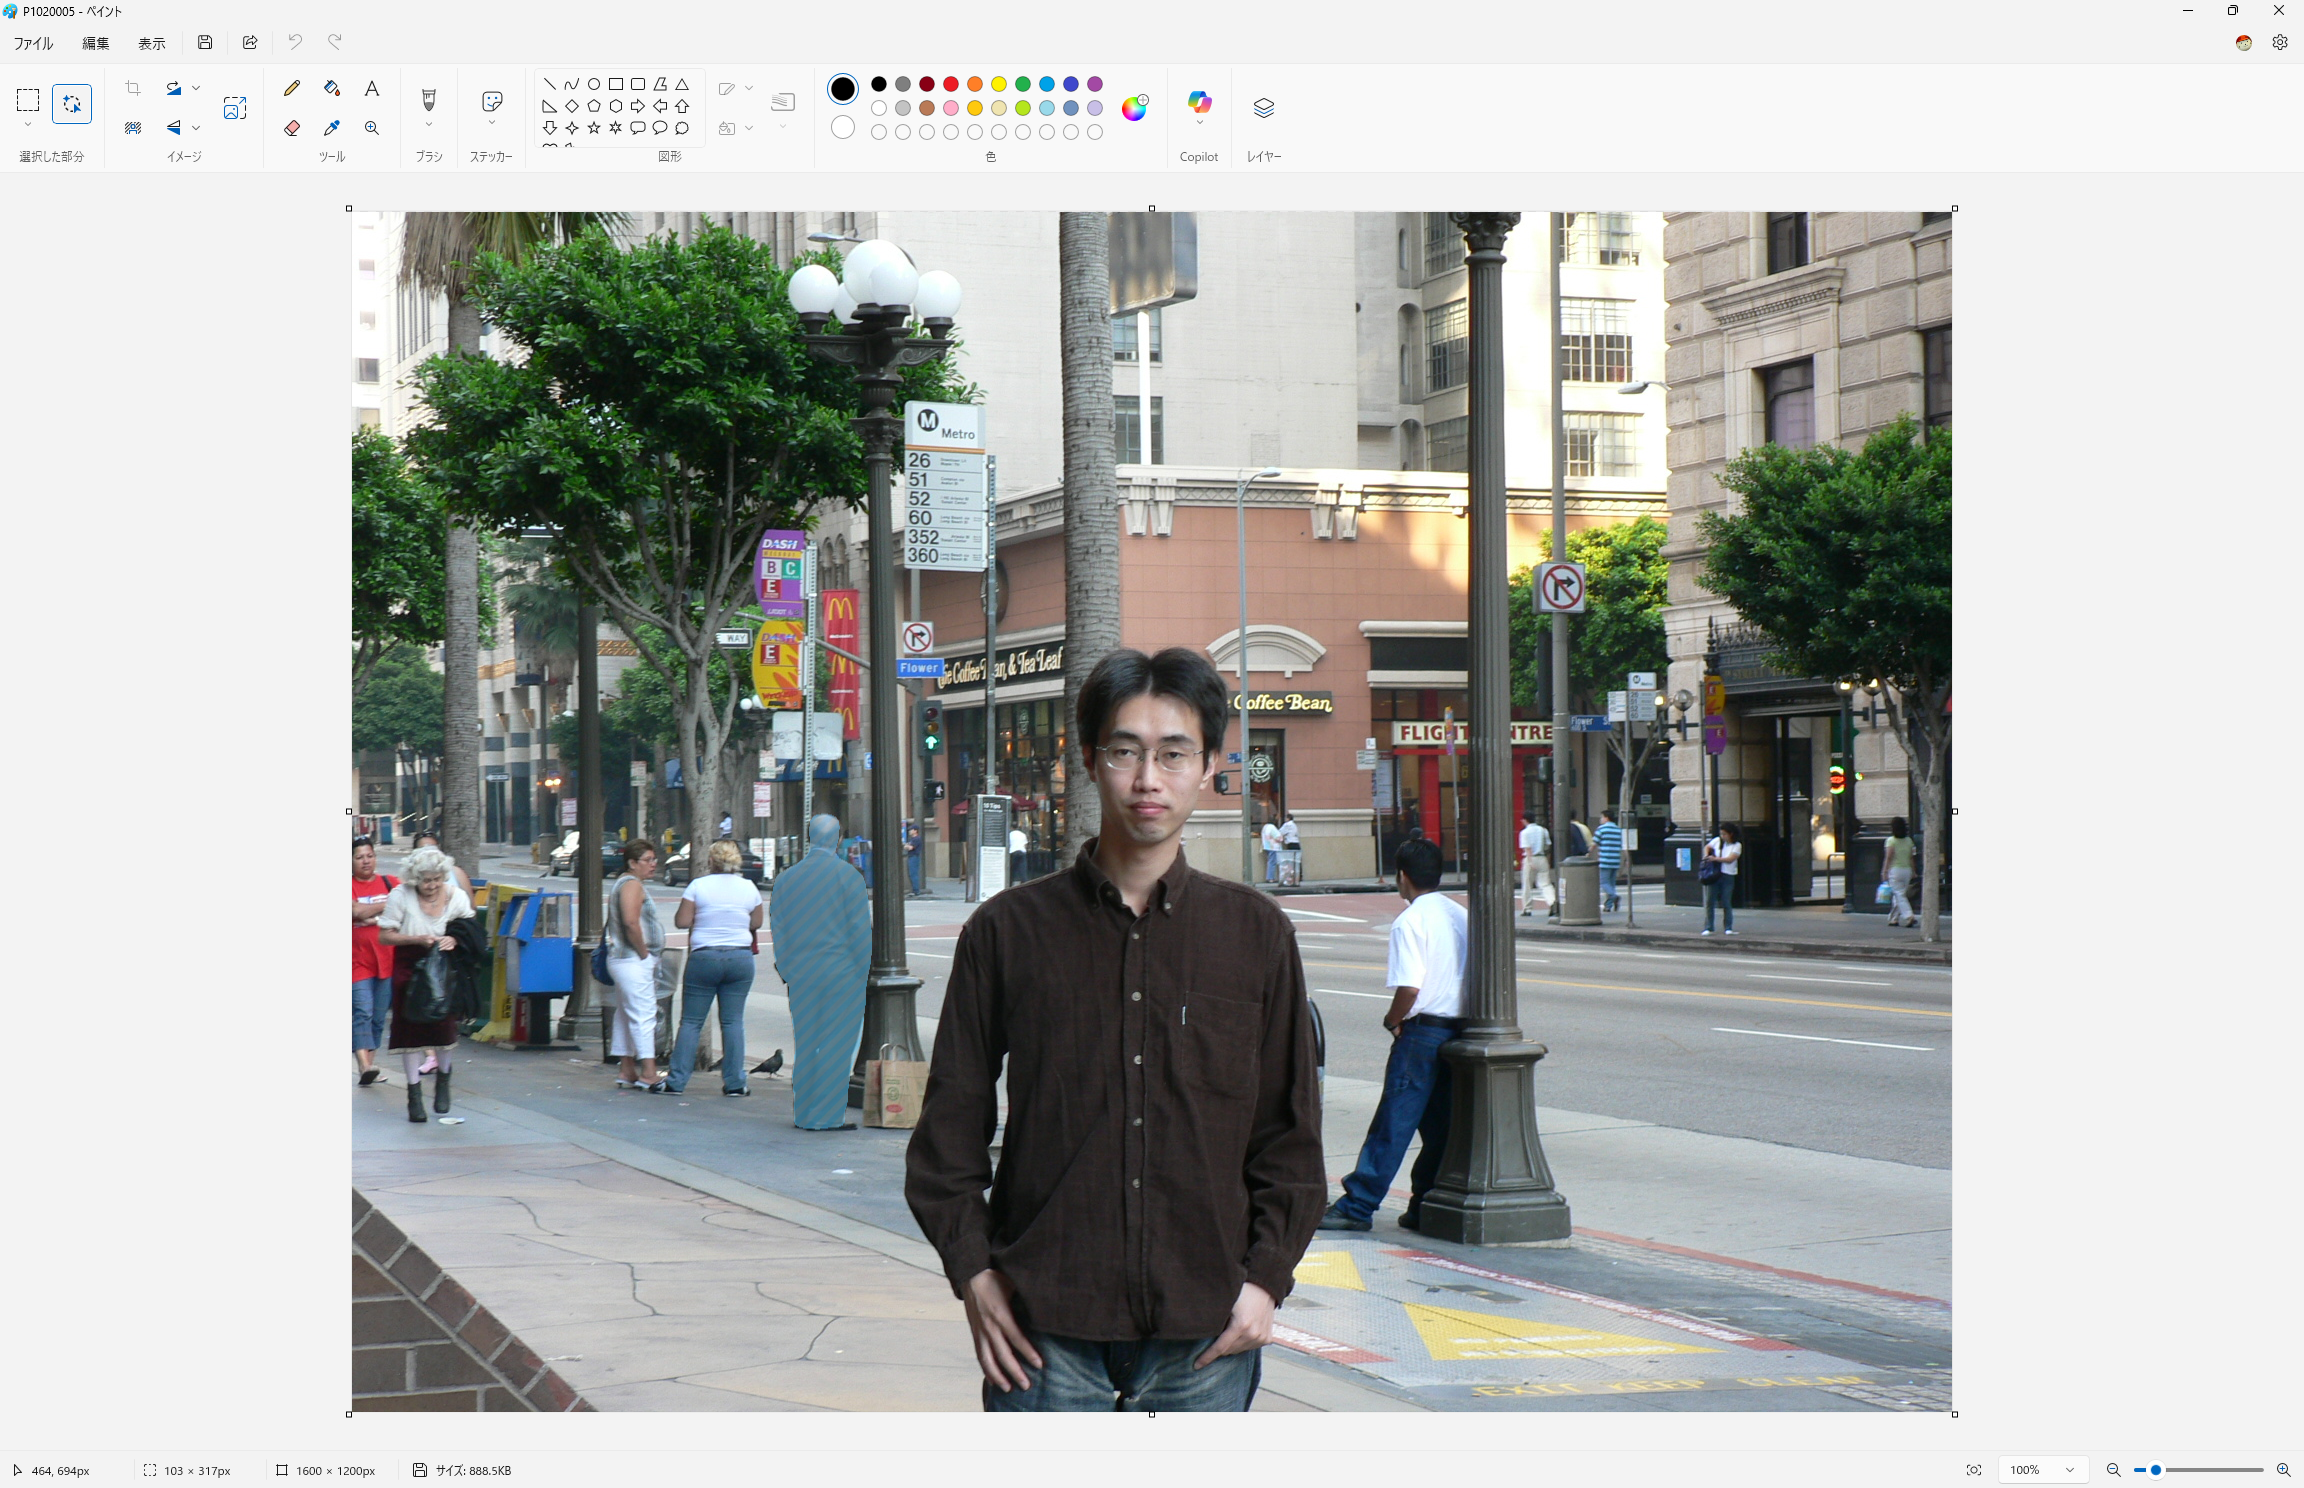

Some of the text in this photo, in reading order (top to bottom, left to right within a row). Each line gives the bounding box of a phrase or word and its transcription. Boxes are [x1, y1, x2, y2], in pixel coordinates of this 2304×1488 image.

[23, 6, 76, 17] P1020005
[86, 5, 122, 18] ペイント
[14, 36, 54, 51] ファイル
[81, 36, 110, 51] 編集
[137, 36, 166, 51] 表示
[19, 150, 85, 163] 選択した部分
[167, 150, 202, 163] イメージ
[319, 150, 346, 163] ツール
[415, 149, 443, 163] ブラシ
[470, 150, 513, 163] ステッカー
[658, 150, 683, 163] 図形
[984, 150, 997, 163] 色
[1179, 151, 1219, 165] Copilot
[1247, 150, 1282, 163] レイヤー
[941, 427, 976, 440] Metro
[908, 452, 931, 468] 26
[908, 471, 928, 487] 51
[908, 491, 931, 506] 52
[908, 510, 932, 525] 60
[762, 538, 798, 549] DASH
[908, 529, 939, 545] 352
[908, 547, 939, 563] 360
[767, 560, 776, 573] B
[785, 561, 796, 575] C
[766, 579, 776, 593] E
[727, 634, 746, 643] WAY
[761, 632, 797, 643] DASH
[765, 645, 776, 660] E
[900, 662, 939, 673] Flower
[953, 660, 981, 684] Coffee
[1008, 652, 1018, 676] &
[1017, 649, 1036, 675] Tea
[1035, 645, 1064, 672] Leaf
[1709, 686, 1716, 694] E
[1233, 694, 1285, 711] Coffee
[1284, 693, 1333, 713] Bean
[1571, 716, 1594, 725] Flower
[1472, 1376, 1876, 1397] EXIT KEEP CLEAR
[31, 1466, 90, 1479] 464, 694px
[164, 1466, 184, 1476] 103
[198, 1466, 231, 1479] 317px
[296, 1466, 323, 1476] 1600
[337, 1466, 376, 1479] 1200px
[436, 1464, 512, 1477] サイズ: 888.5KB
[2010, 1464, 2040, 1475] 100%
